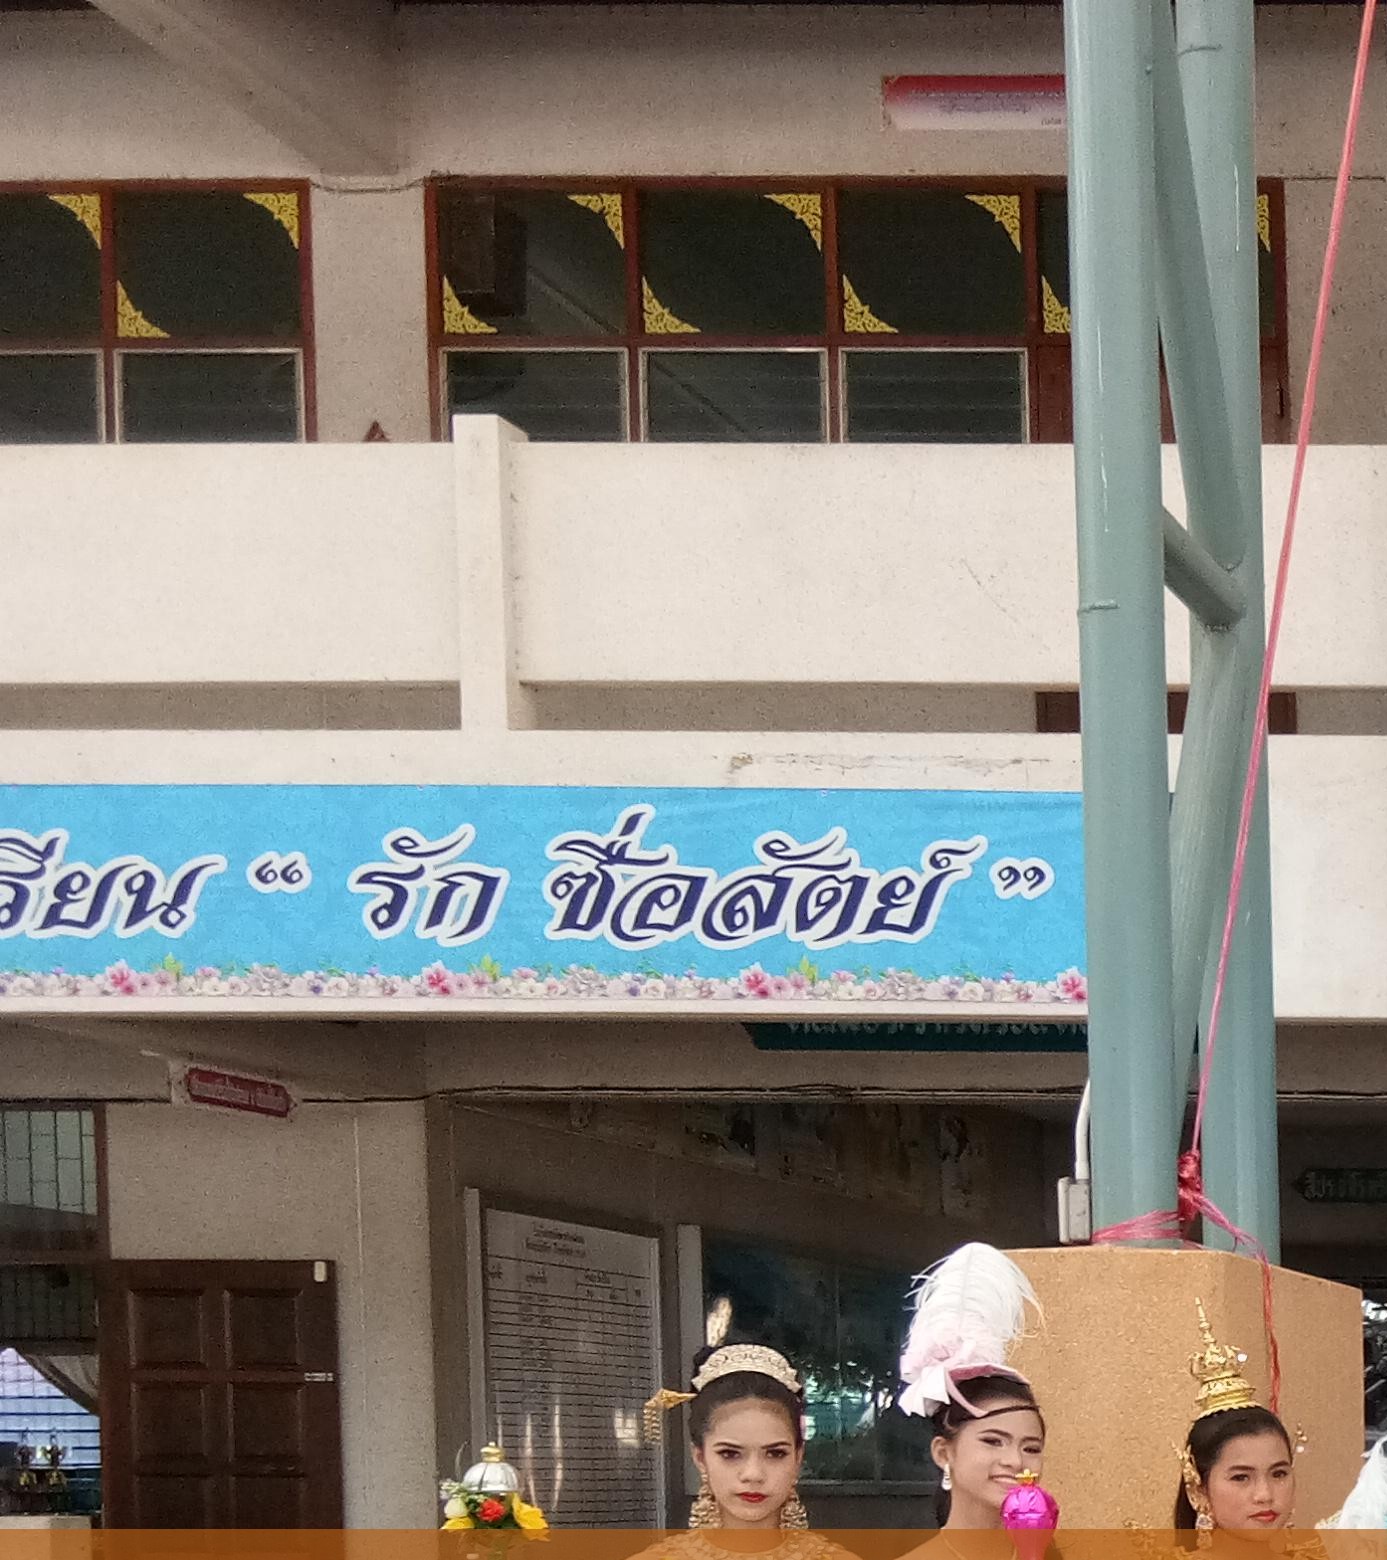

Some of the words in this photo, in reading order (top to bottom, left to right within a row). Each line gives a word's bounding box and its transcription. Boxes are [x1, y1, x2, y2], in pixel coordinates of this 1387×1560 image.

[356, 833, 500, 938] รัก
[550, 812, 981, 942] ซื่อสัตย์
